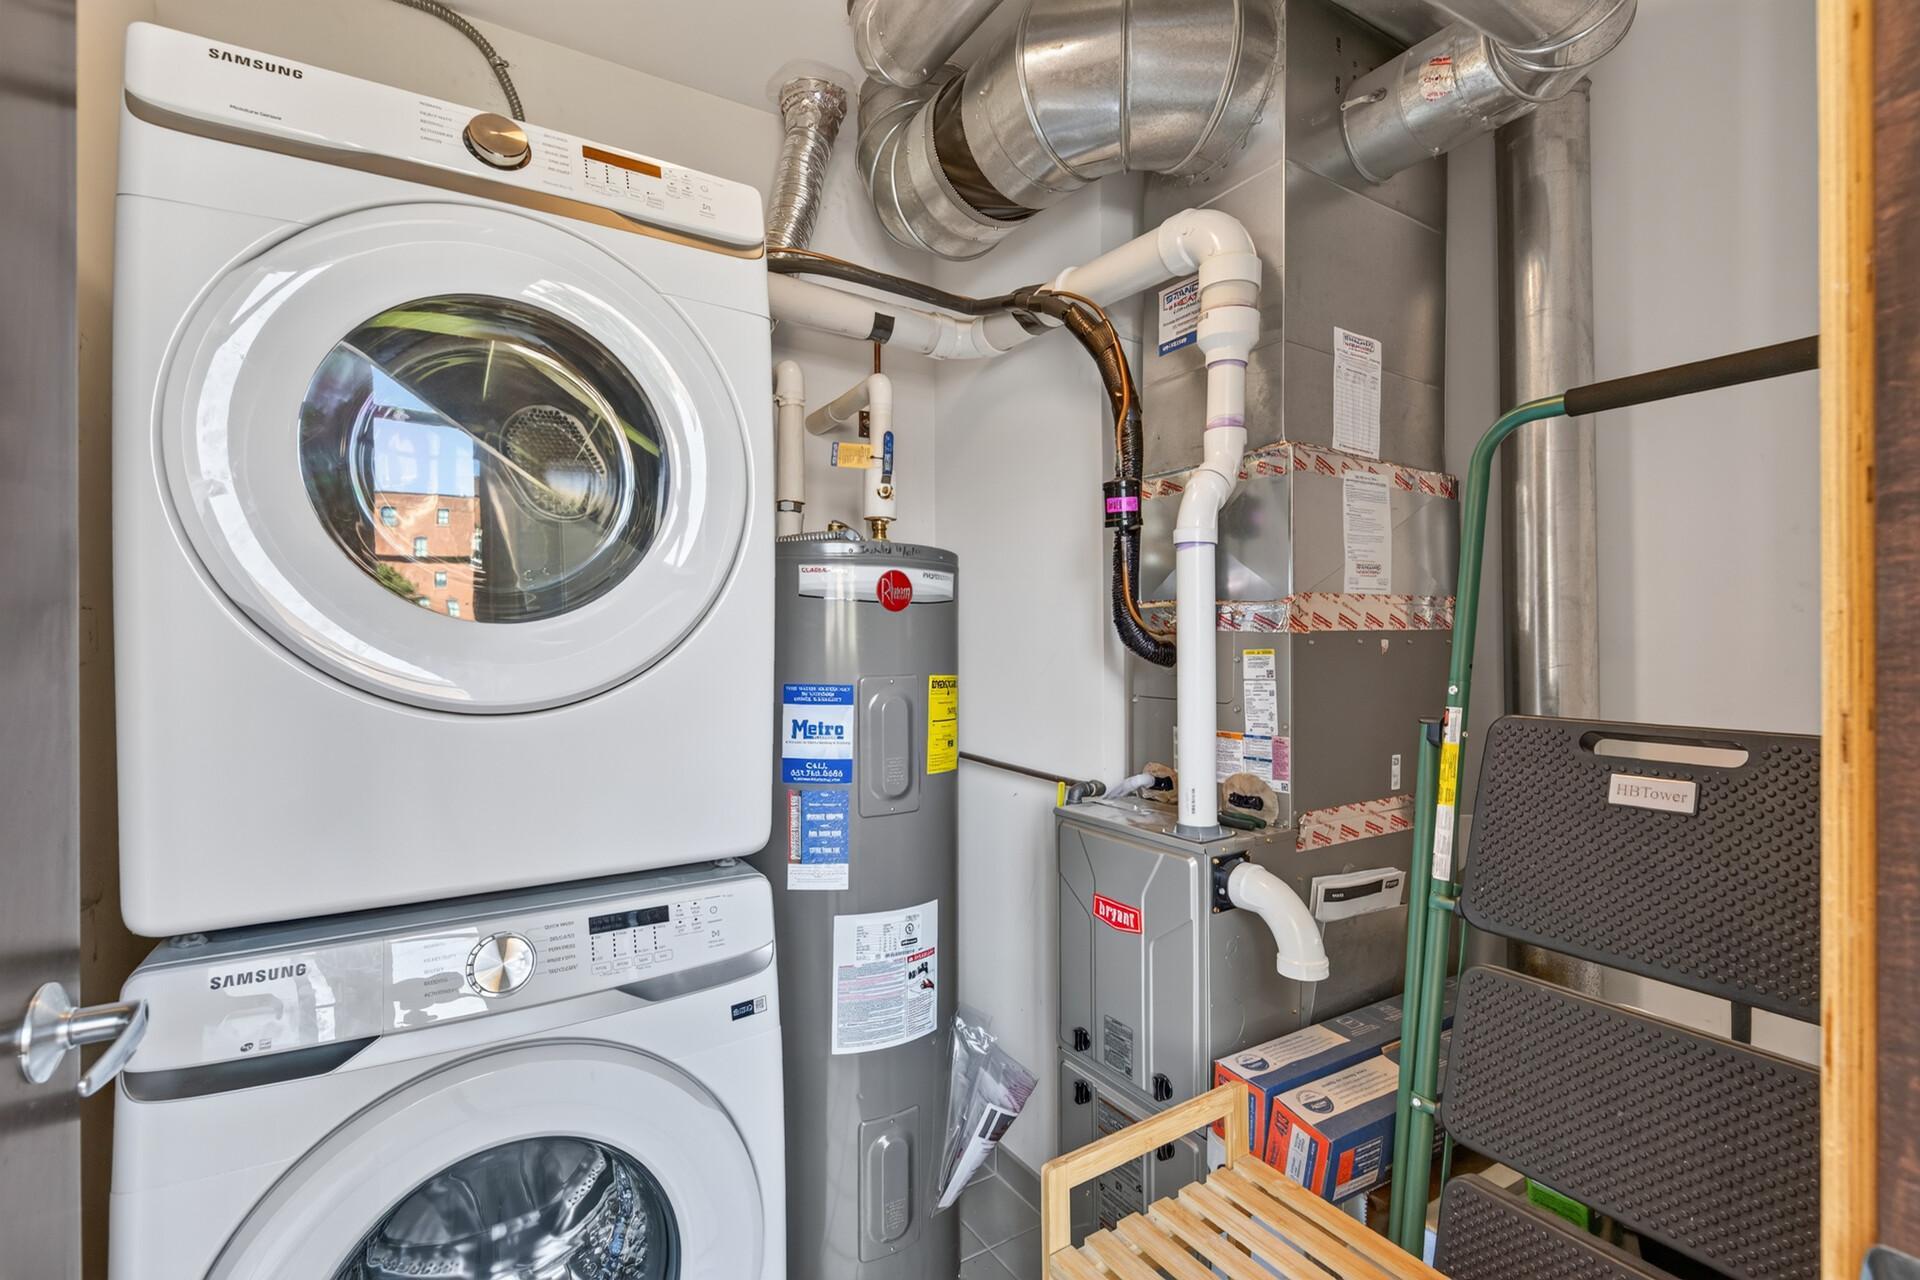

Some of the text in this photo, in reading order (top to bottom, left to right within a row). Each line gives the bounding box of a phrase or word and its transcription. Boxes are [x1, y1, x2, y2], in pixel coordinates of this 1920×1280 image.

[208, 48, 303, 79] SAMSUNG
[881, 572, 911, 606] Rheem
[791, 719, 844, 740] Metro
[1616, 783, 1688, 803] HBTower
[1098, 900, 1135, 929] bryant
[210, 963, 307, 990] SAMSUNG
